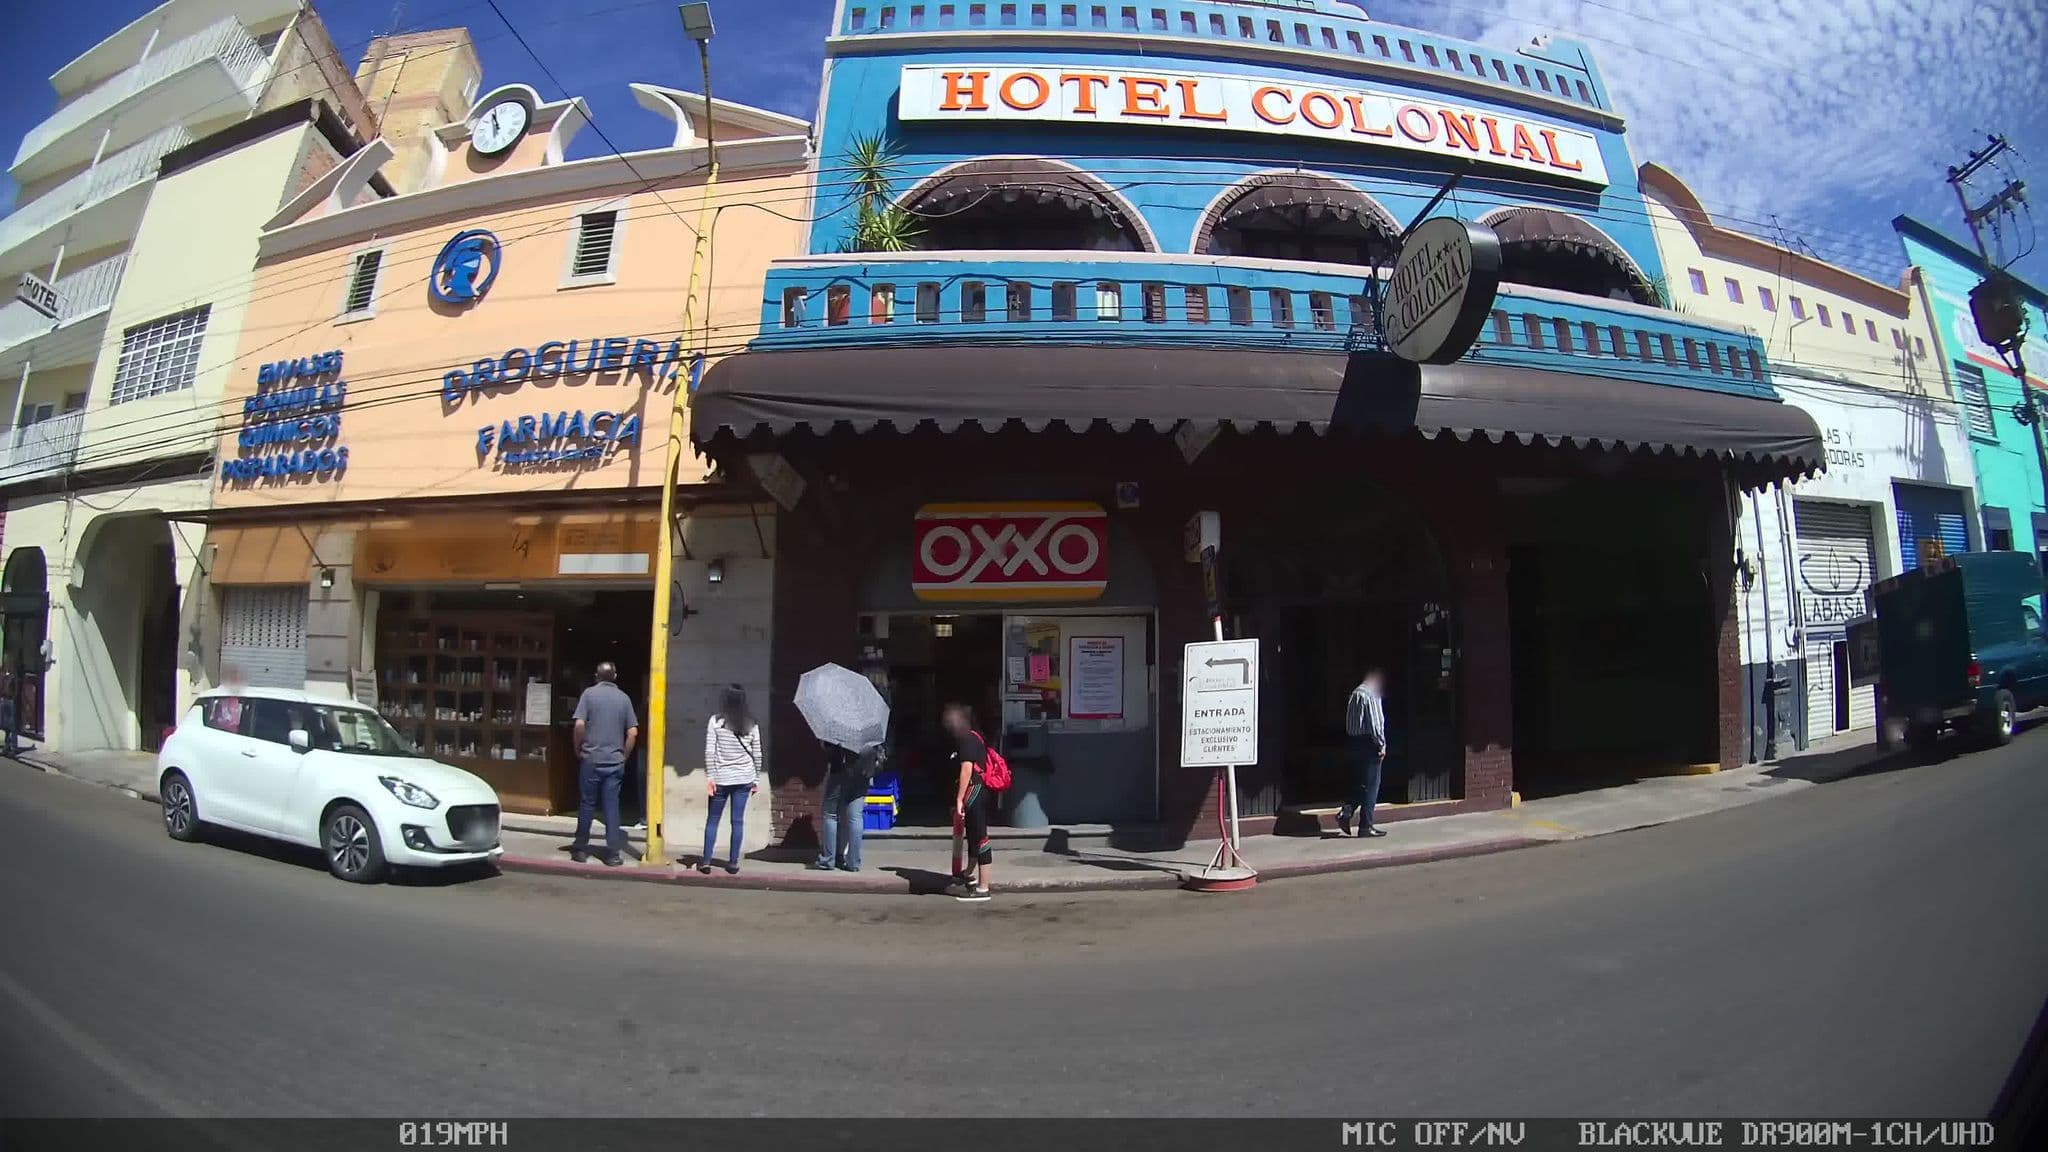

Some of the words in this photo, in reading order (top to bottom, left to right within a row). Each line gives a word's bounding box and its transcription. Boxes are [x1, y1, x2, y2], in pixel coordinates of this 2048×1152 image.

[939, 71, 1228, 123] HOTEL
[1251, 86, 1584, 173] COLONIAL
[1393, 243, 1436, 303] HOTEL
[1401, 248, 1470, 330] COLONIAL
[25, 276, 59, 313] HOTEL
[441, 335, 704, 402] DROGUERIA
[477, 410, 641, 456] FARMACIA
[1822, 427, 1840, 444] AS
[1846, 431, 1853, 446] Y
[220, 446, 349, 482] PREPARADOS
[920, 523, 1099, 583] OXXO
[1802, 597, 1864, 622] LABASA
[1194, 707, 1246, 718] ENTRADA
[1189, 726, 1251, 736] ESTACIONAMIENTO
[1201, 735, 1238, 744] EXCLUSIVO
[1203, 745, 1236, 753] CLIENTES
